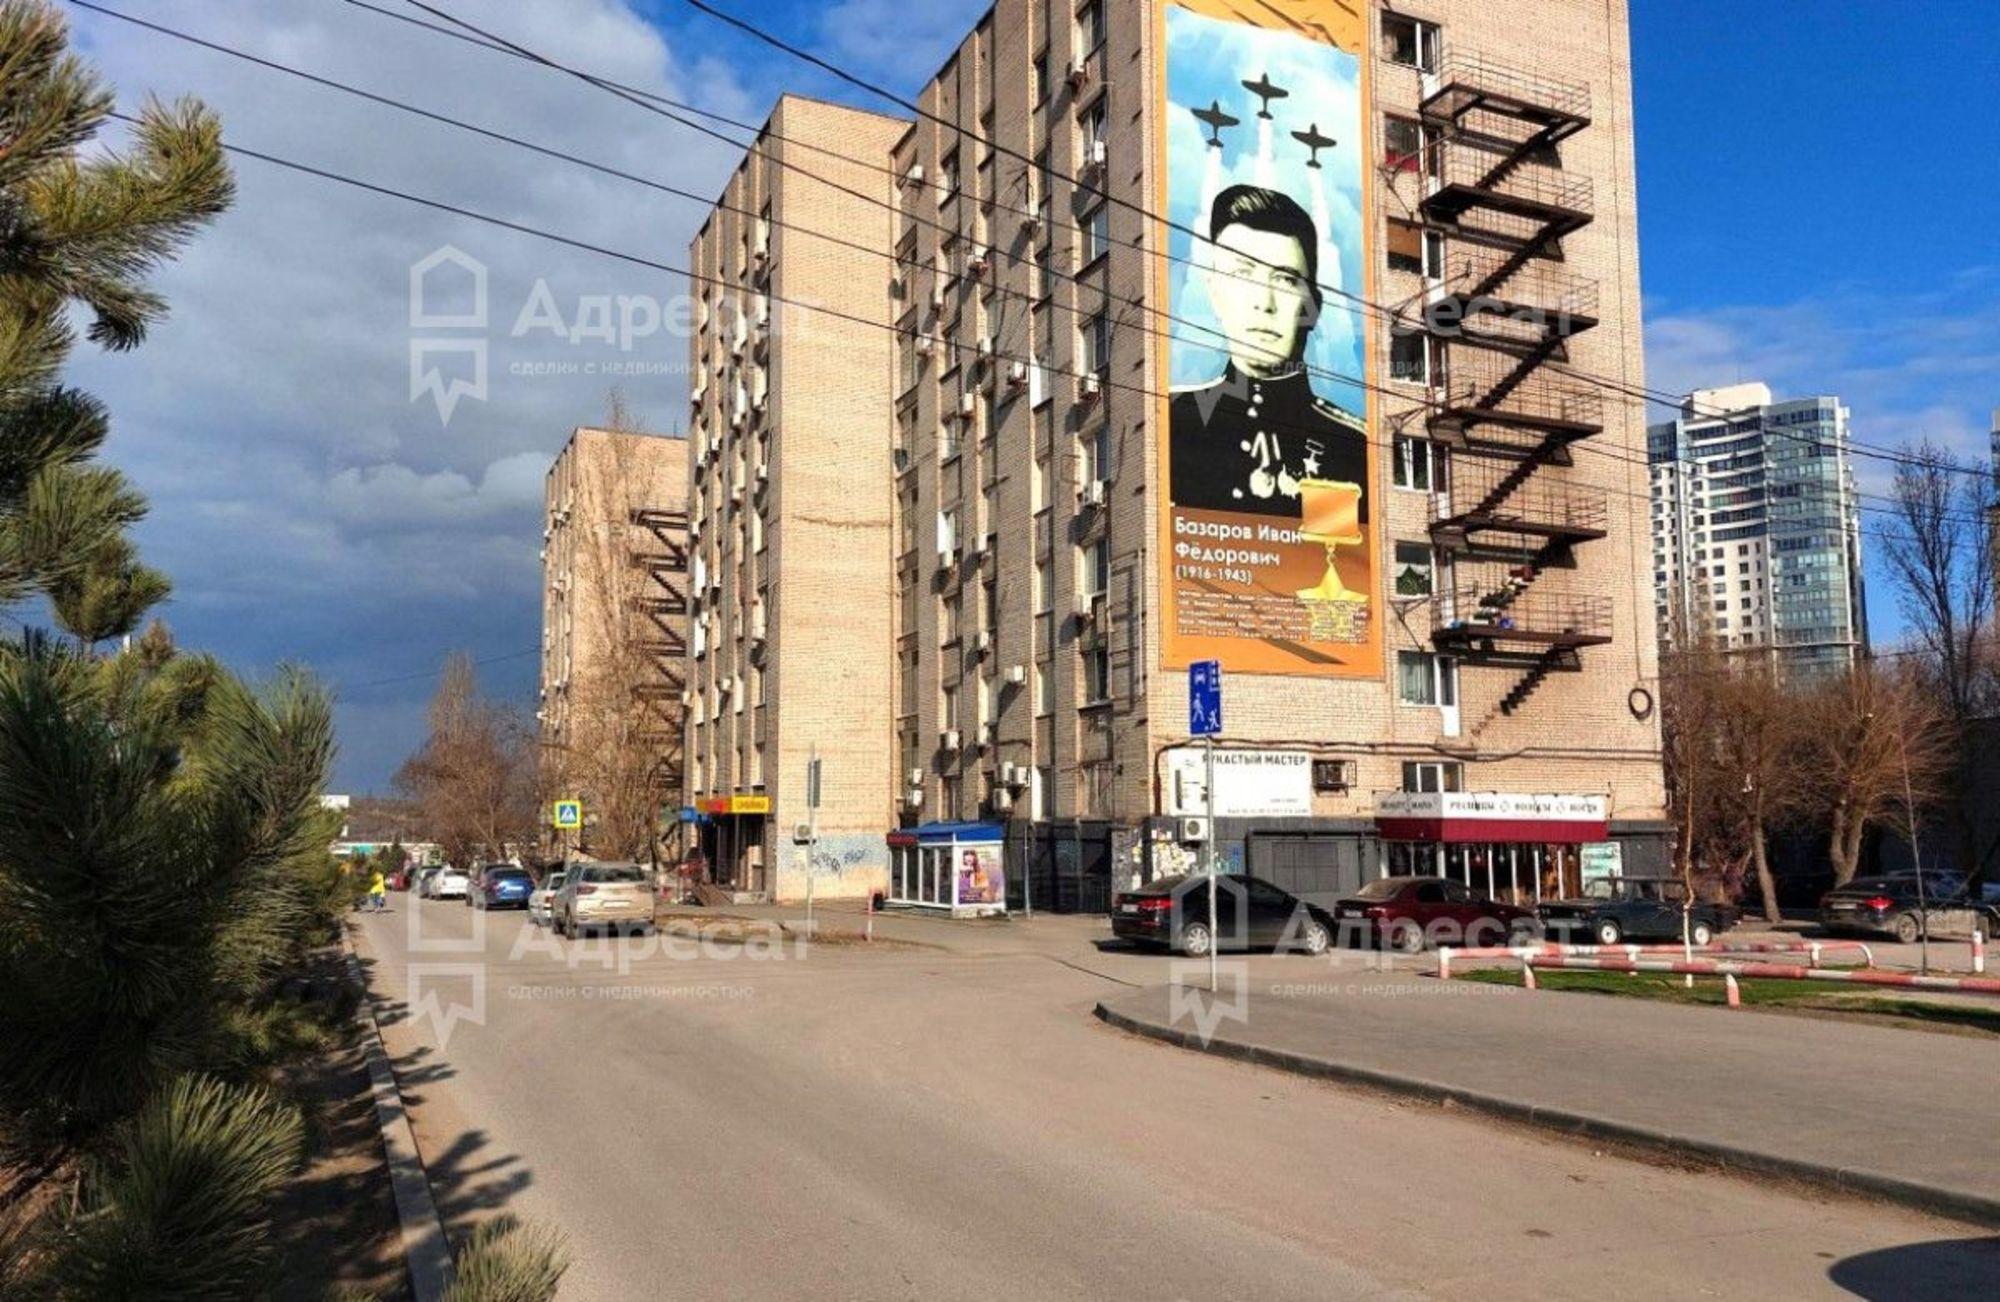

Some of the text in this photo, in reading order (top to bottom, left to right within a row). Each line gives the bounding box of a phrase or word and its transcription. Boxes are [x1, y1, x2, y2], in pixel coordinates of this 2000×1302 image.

[1175, 516, 1301, 543] Базаров Иван
[1175, 541, 1280, 566] Фёдорович
[1175, 564, 1253, 586] (1916-1943)
[1264, 754, 1307, 766] МАСТЕР
